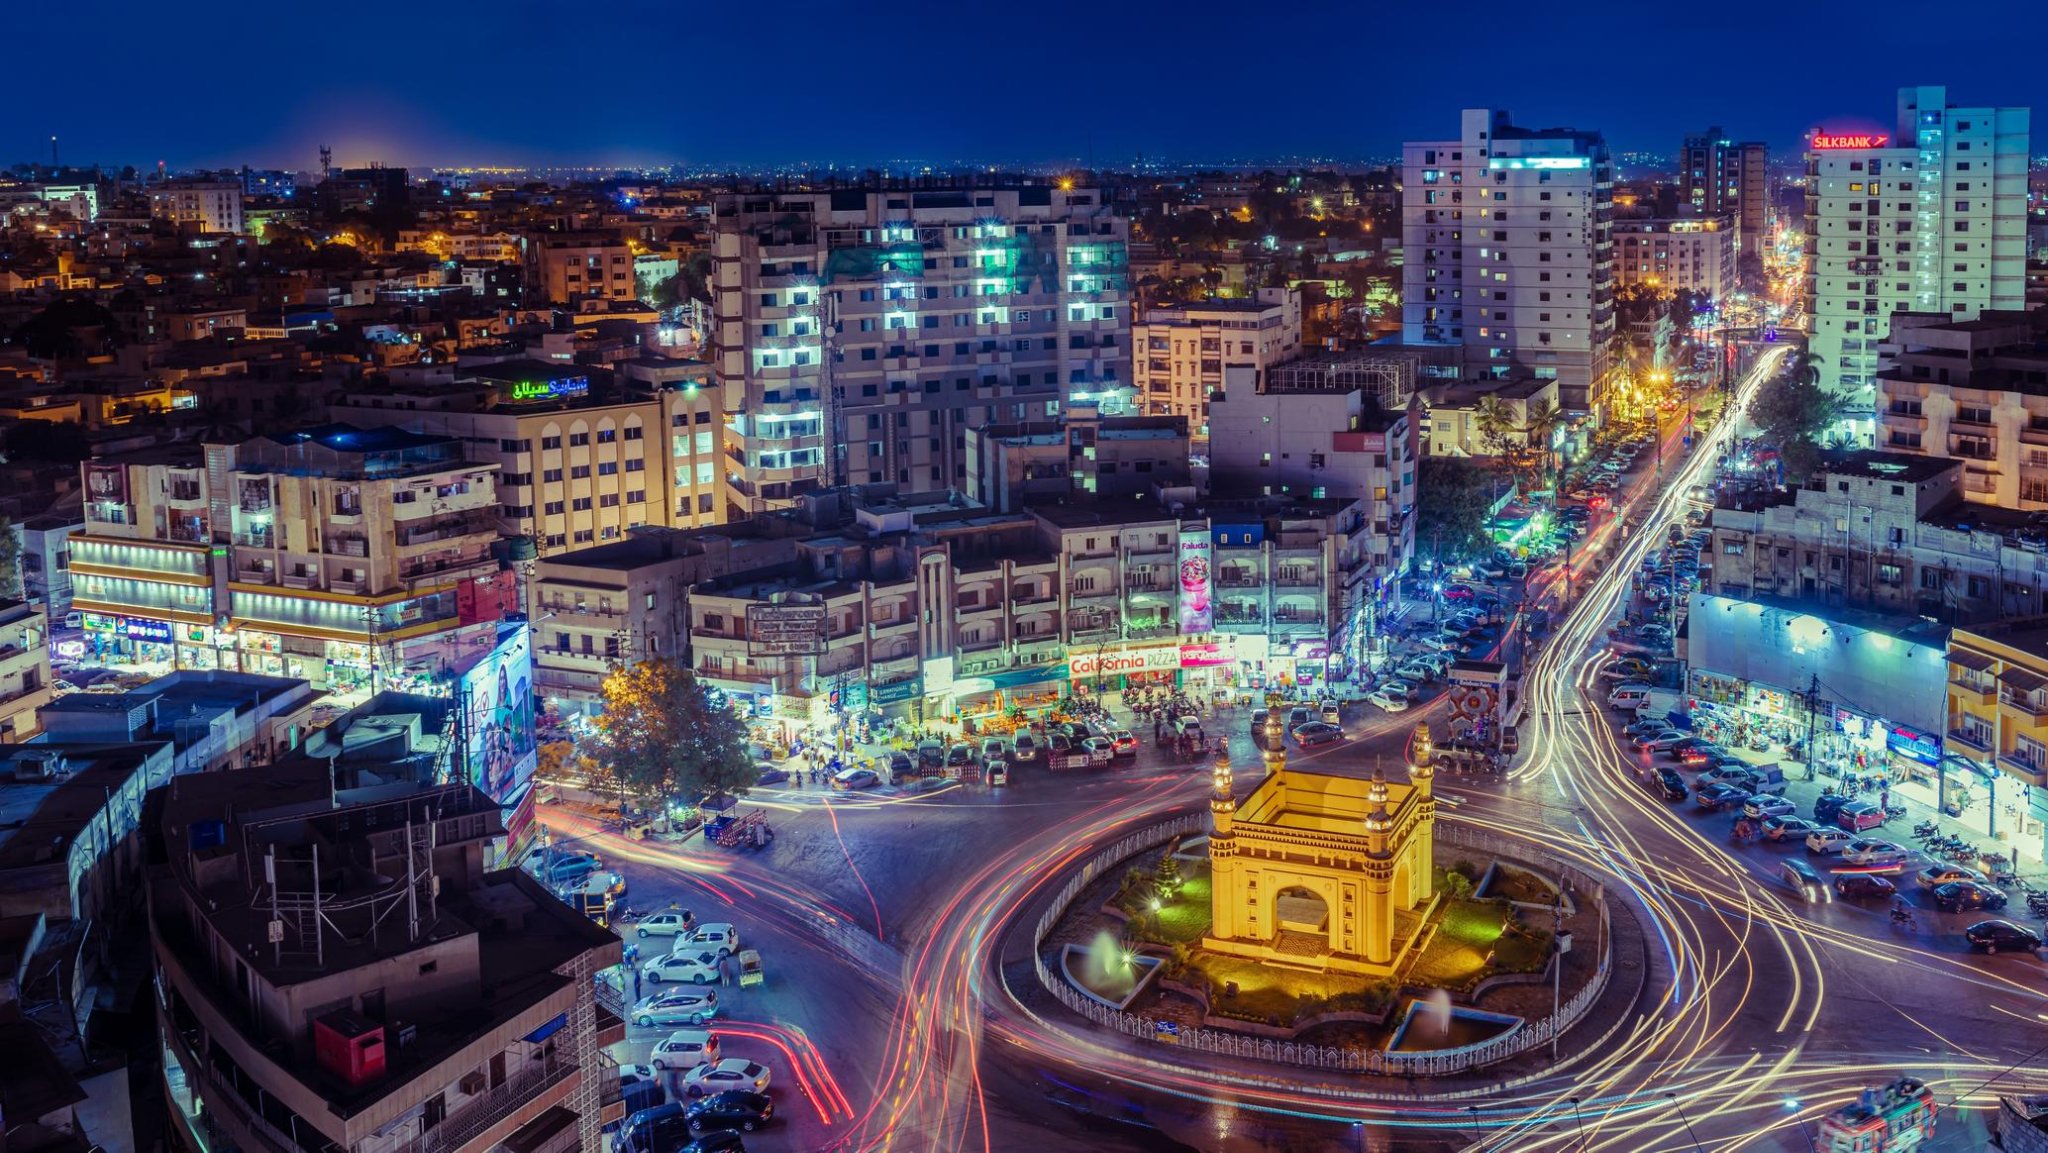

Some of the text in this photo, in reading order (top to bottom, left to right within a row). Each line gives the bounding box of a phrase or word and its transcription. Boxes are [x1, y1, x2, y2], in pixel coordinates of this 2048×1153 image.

[1814, 136, 1871, 148] SILKBANK
[1071, 651, 1178, 674] California PIZZA
